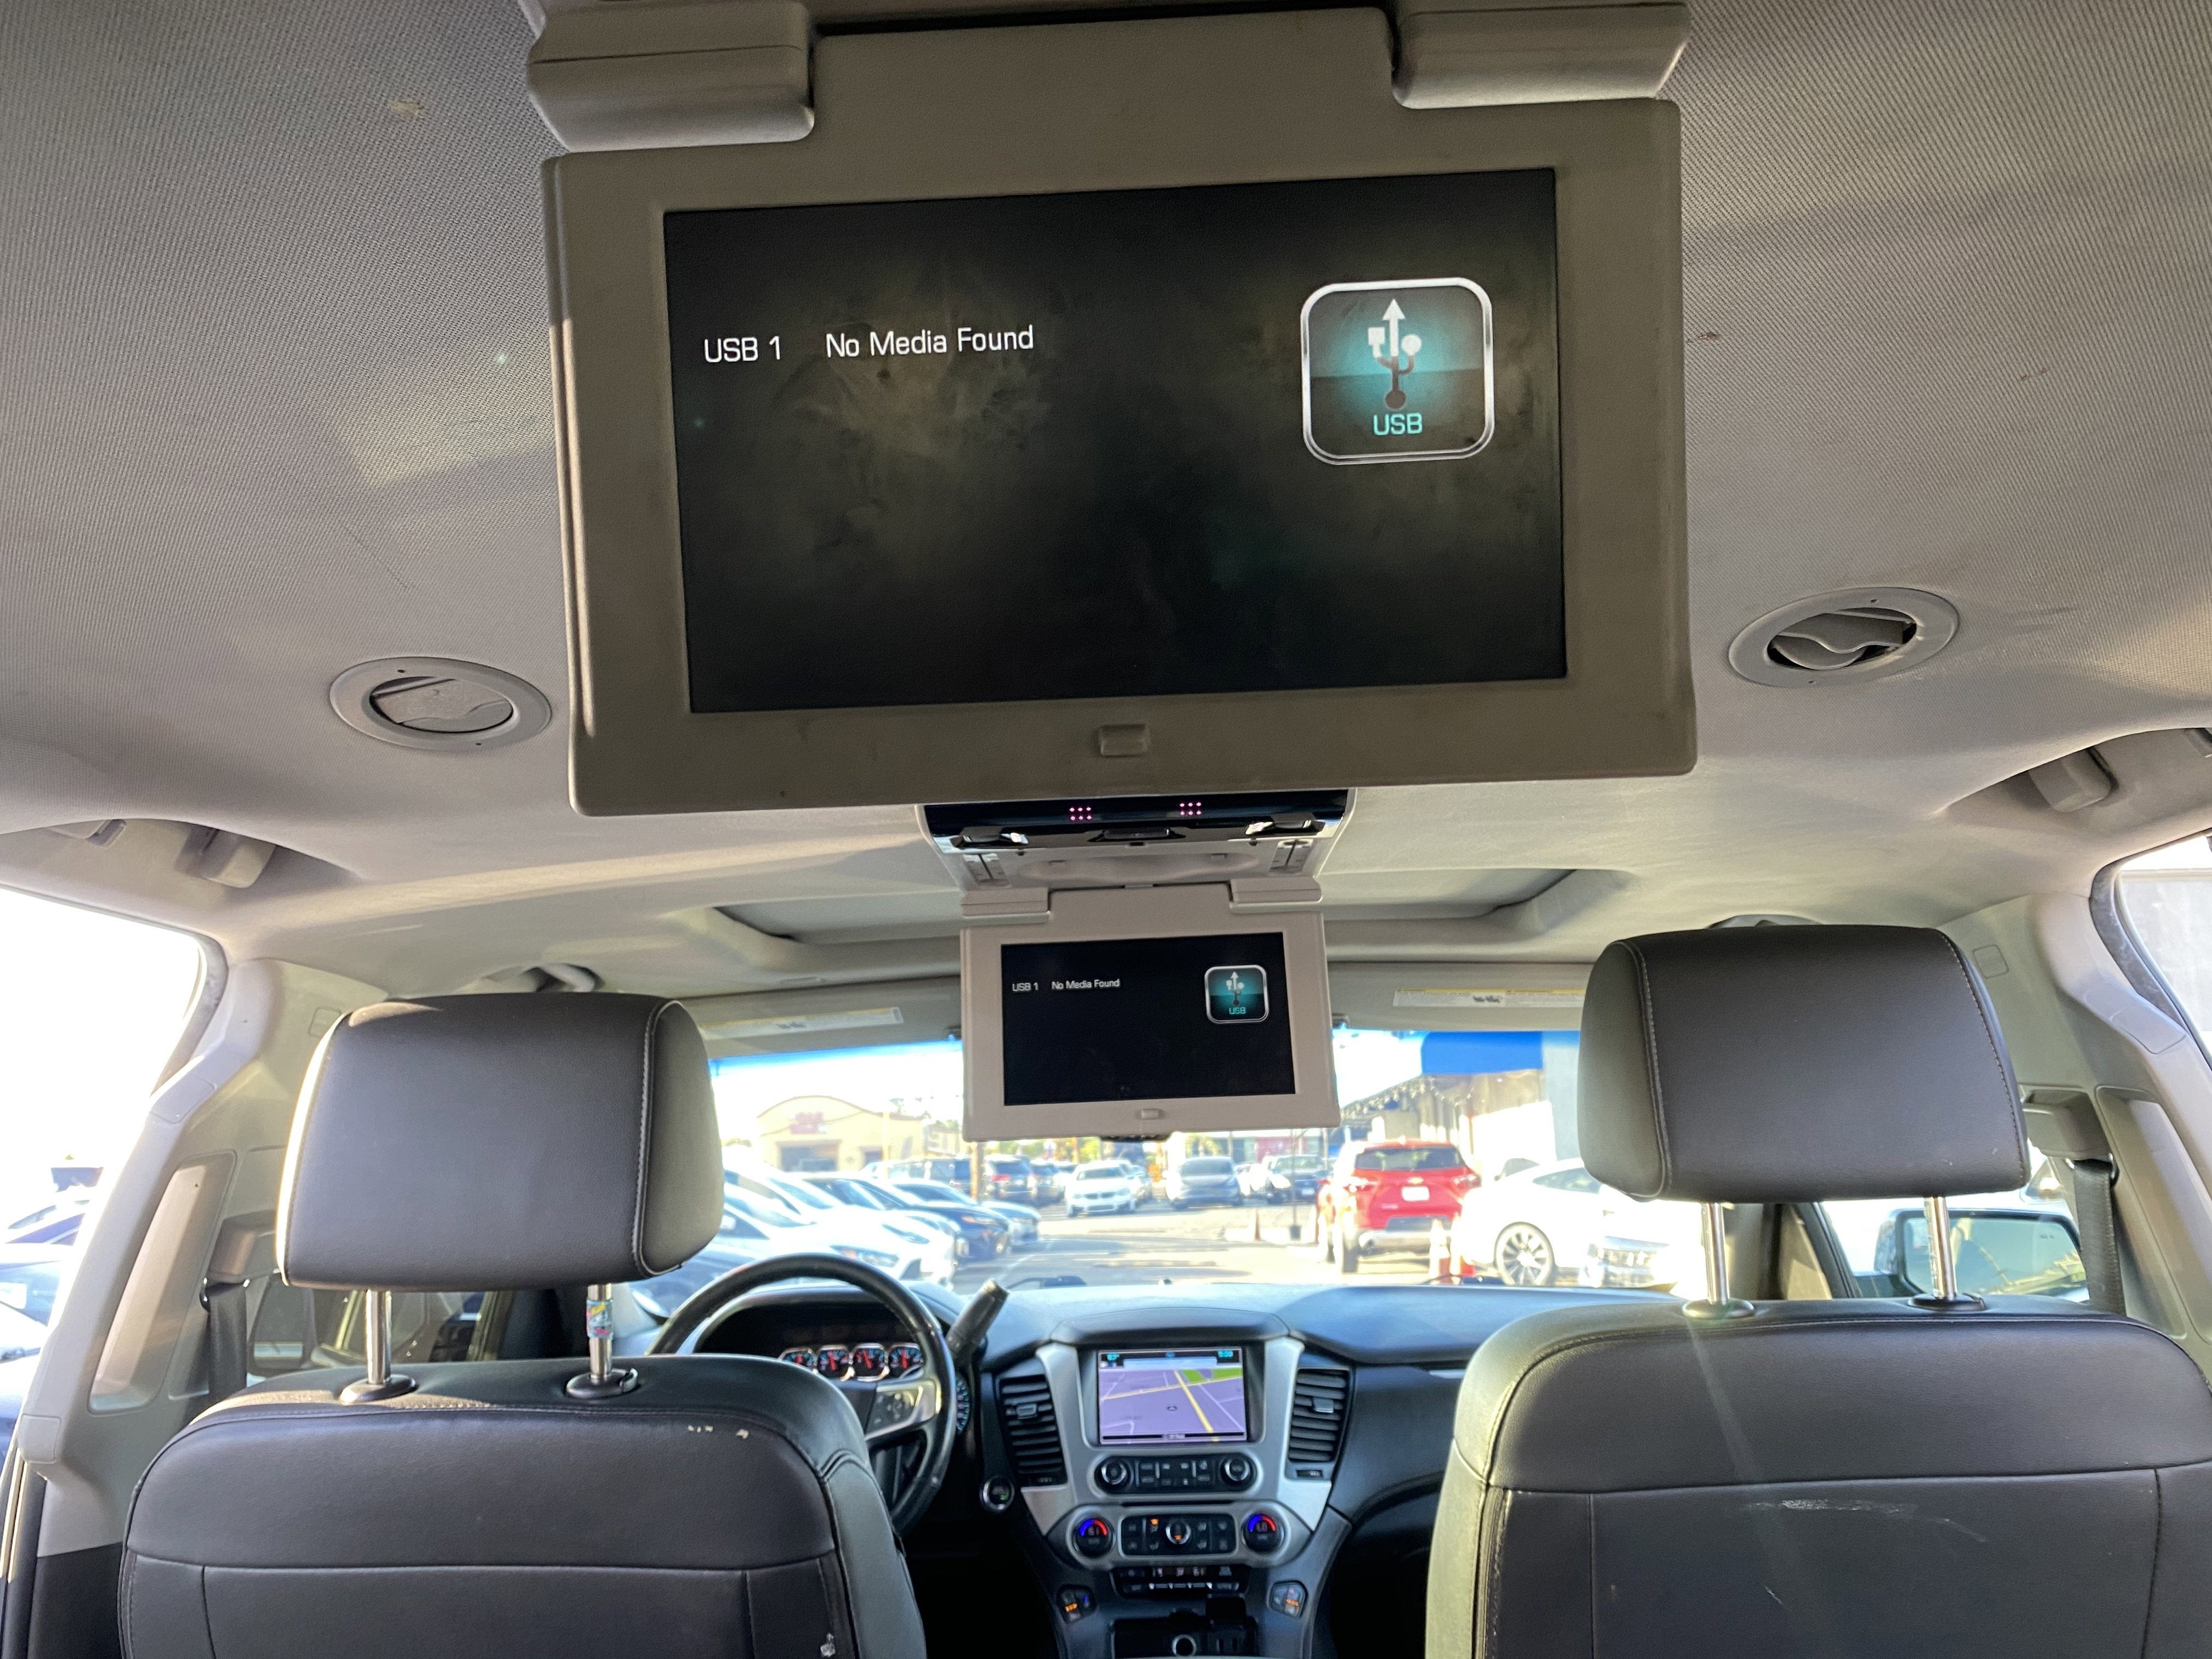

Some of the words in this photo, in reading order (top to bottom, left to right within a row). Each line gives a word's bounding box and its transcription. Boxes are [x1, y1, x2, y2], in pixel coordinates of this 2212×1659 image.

[703, 337, 759, 363] USB
[769, 335, 781, 360] 1
[826, 333, 860, 358] No
[870, 330, 947, 357] Media
[957, 325, 1034, 352] Found
[1373, 412, 1423, 436] USB
[1012, 983, 1031, 991] USB
[1034, 982, 1039, 990] 1
[1051, 981, 1064, 989] No
[1066, 980, 1092, 989] Media
[1094, 978, 1120, 988] Found
[1228, 1006, 1246, 1014] USB
